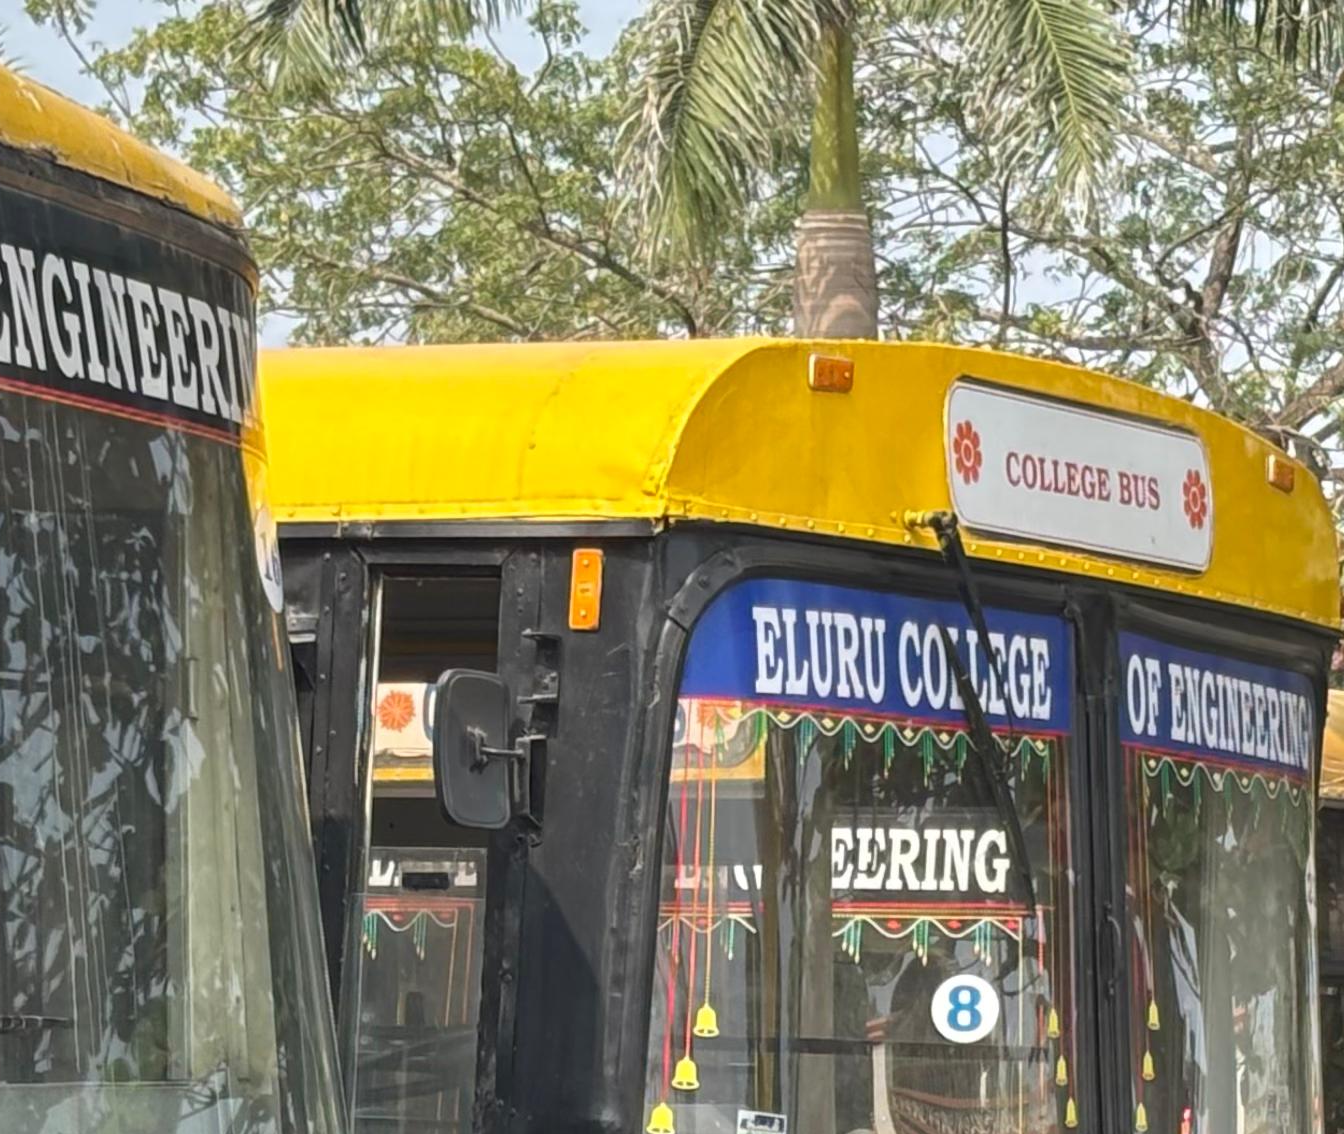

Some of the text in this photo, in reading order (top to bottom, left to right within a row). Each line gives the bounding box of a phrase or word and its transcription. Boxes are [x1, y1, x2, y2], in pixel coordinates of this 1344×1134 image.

[1006, 451, 1161, 511] COLLEGE BUS
[752, 605, 887, 704] ELURU
[1127, 654, 1310, 770] OF ENGINEERING
[947, 985, 982, 1032] 8
